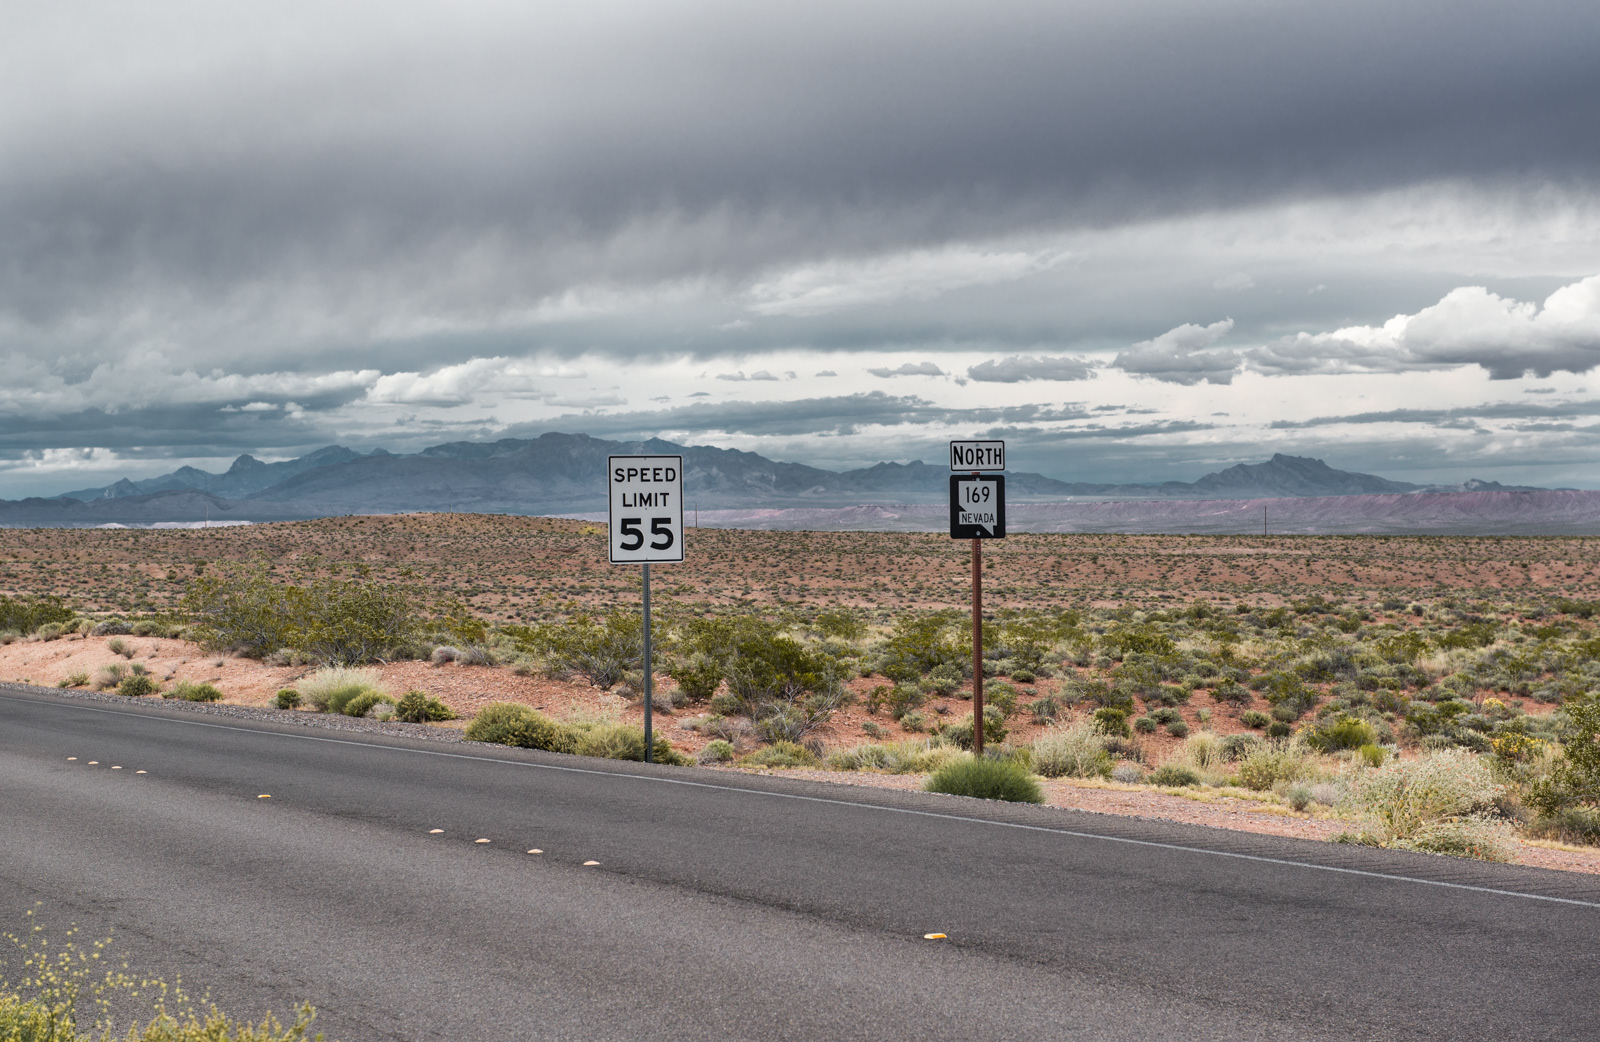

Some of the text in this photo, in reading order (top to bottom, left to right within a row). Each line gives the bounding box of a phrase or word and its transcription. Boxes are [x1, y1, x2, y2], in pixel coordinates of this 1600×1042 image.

[953, 445, 1002, 465] NORTH
[614, 467, 676, 482] SPEED
[622, 492, 670, 507] LIMIT
[966, 486, 990, 503] 169
[961, 512, 995, 523] NEVADA
[620, 517, 674, 551] 55
